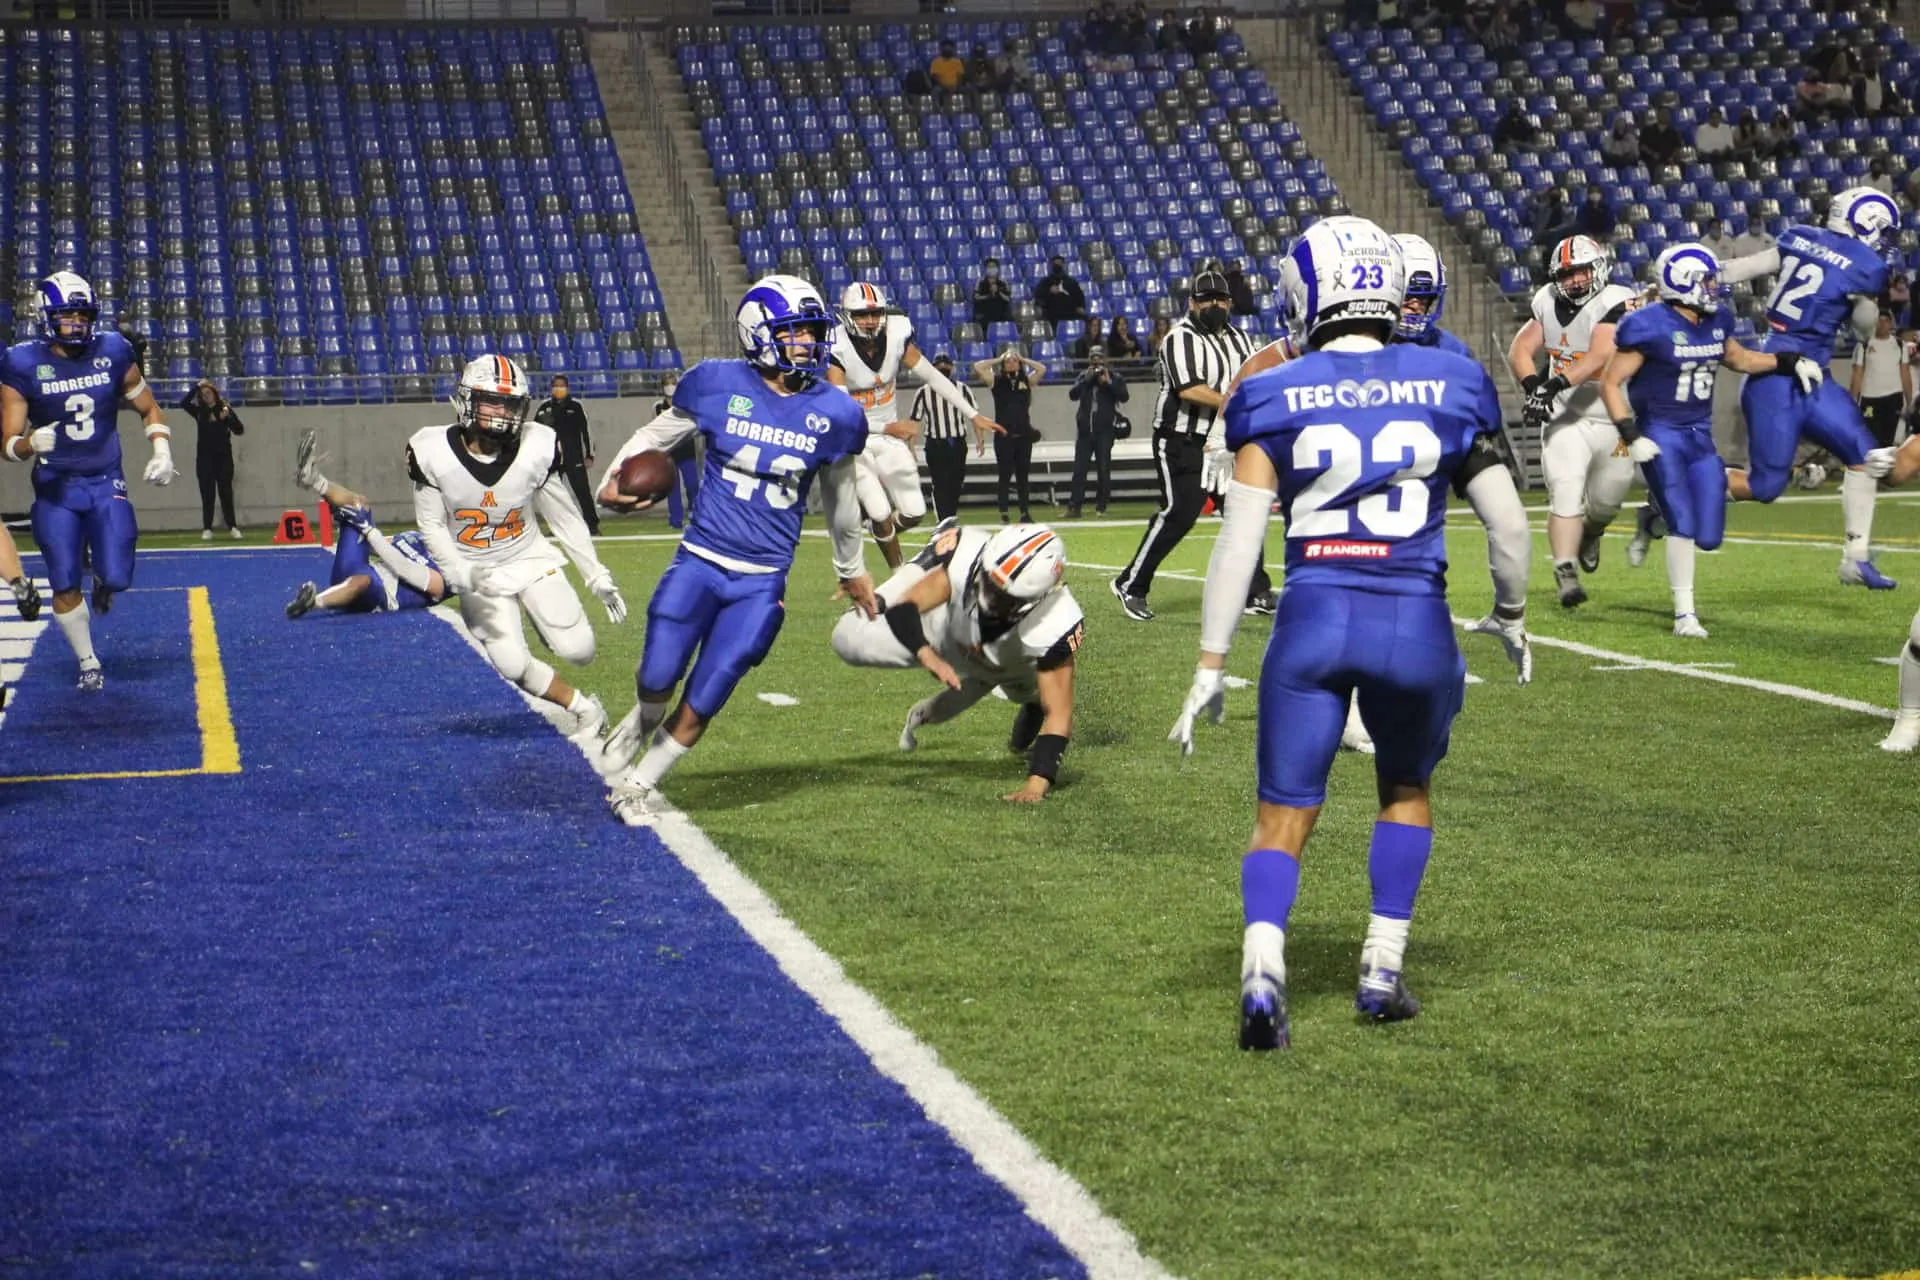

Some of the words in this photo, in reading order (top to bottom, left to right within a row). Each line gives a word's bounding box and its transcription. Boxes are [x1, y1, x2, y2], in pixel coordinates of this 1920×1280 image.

[1351, 264, 1384, 290] 23
[1767, 256, 1824, 320] 12
[42, 372, 111, 395] BORREGOS
[1284, 384, 1334, 413] TEC
[1390, 380, 1446, 406] MTY
[65, 393, 95, 440] 3
[725, 417, 818, 454] BORREGOS
[722, 444, 807, 510] 43
[1287, 420, 1442, 538] 23
[285, 516, 305, 541] G
[454, 506, 526, 549] 24
[1323, 544, 1388, 557] BANORTE
